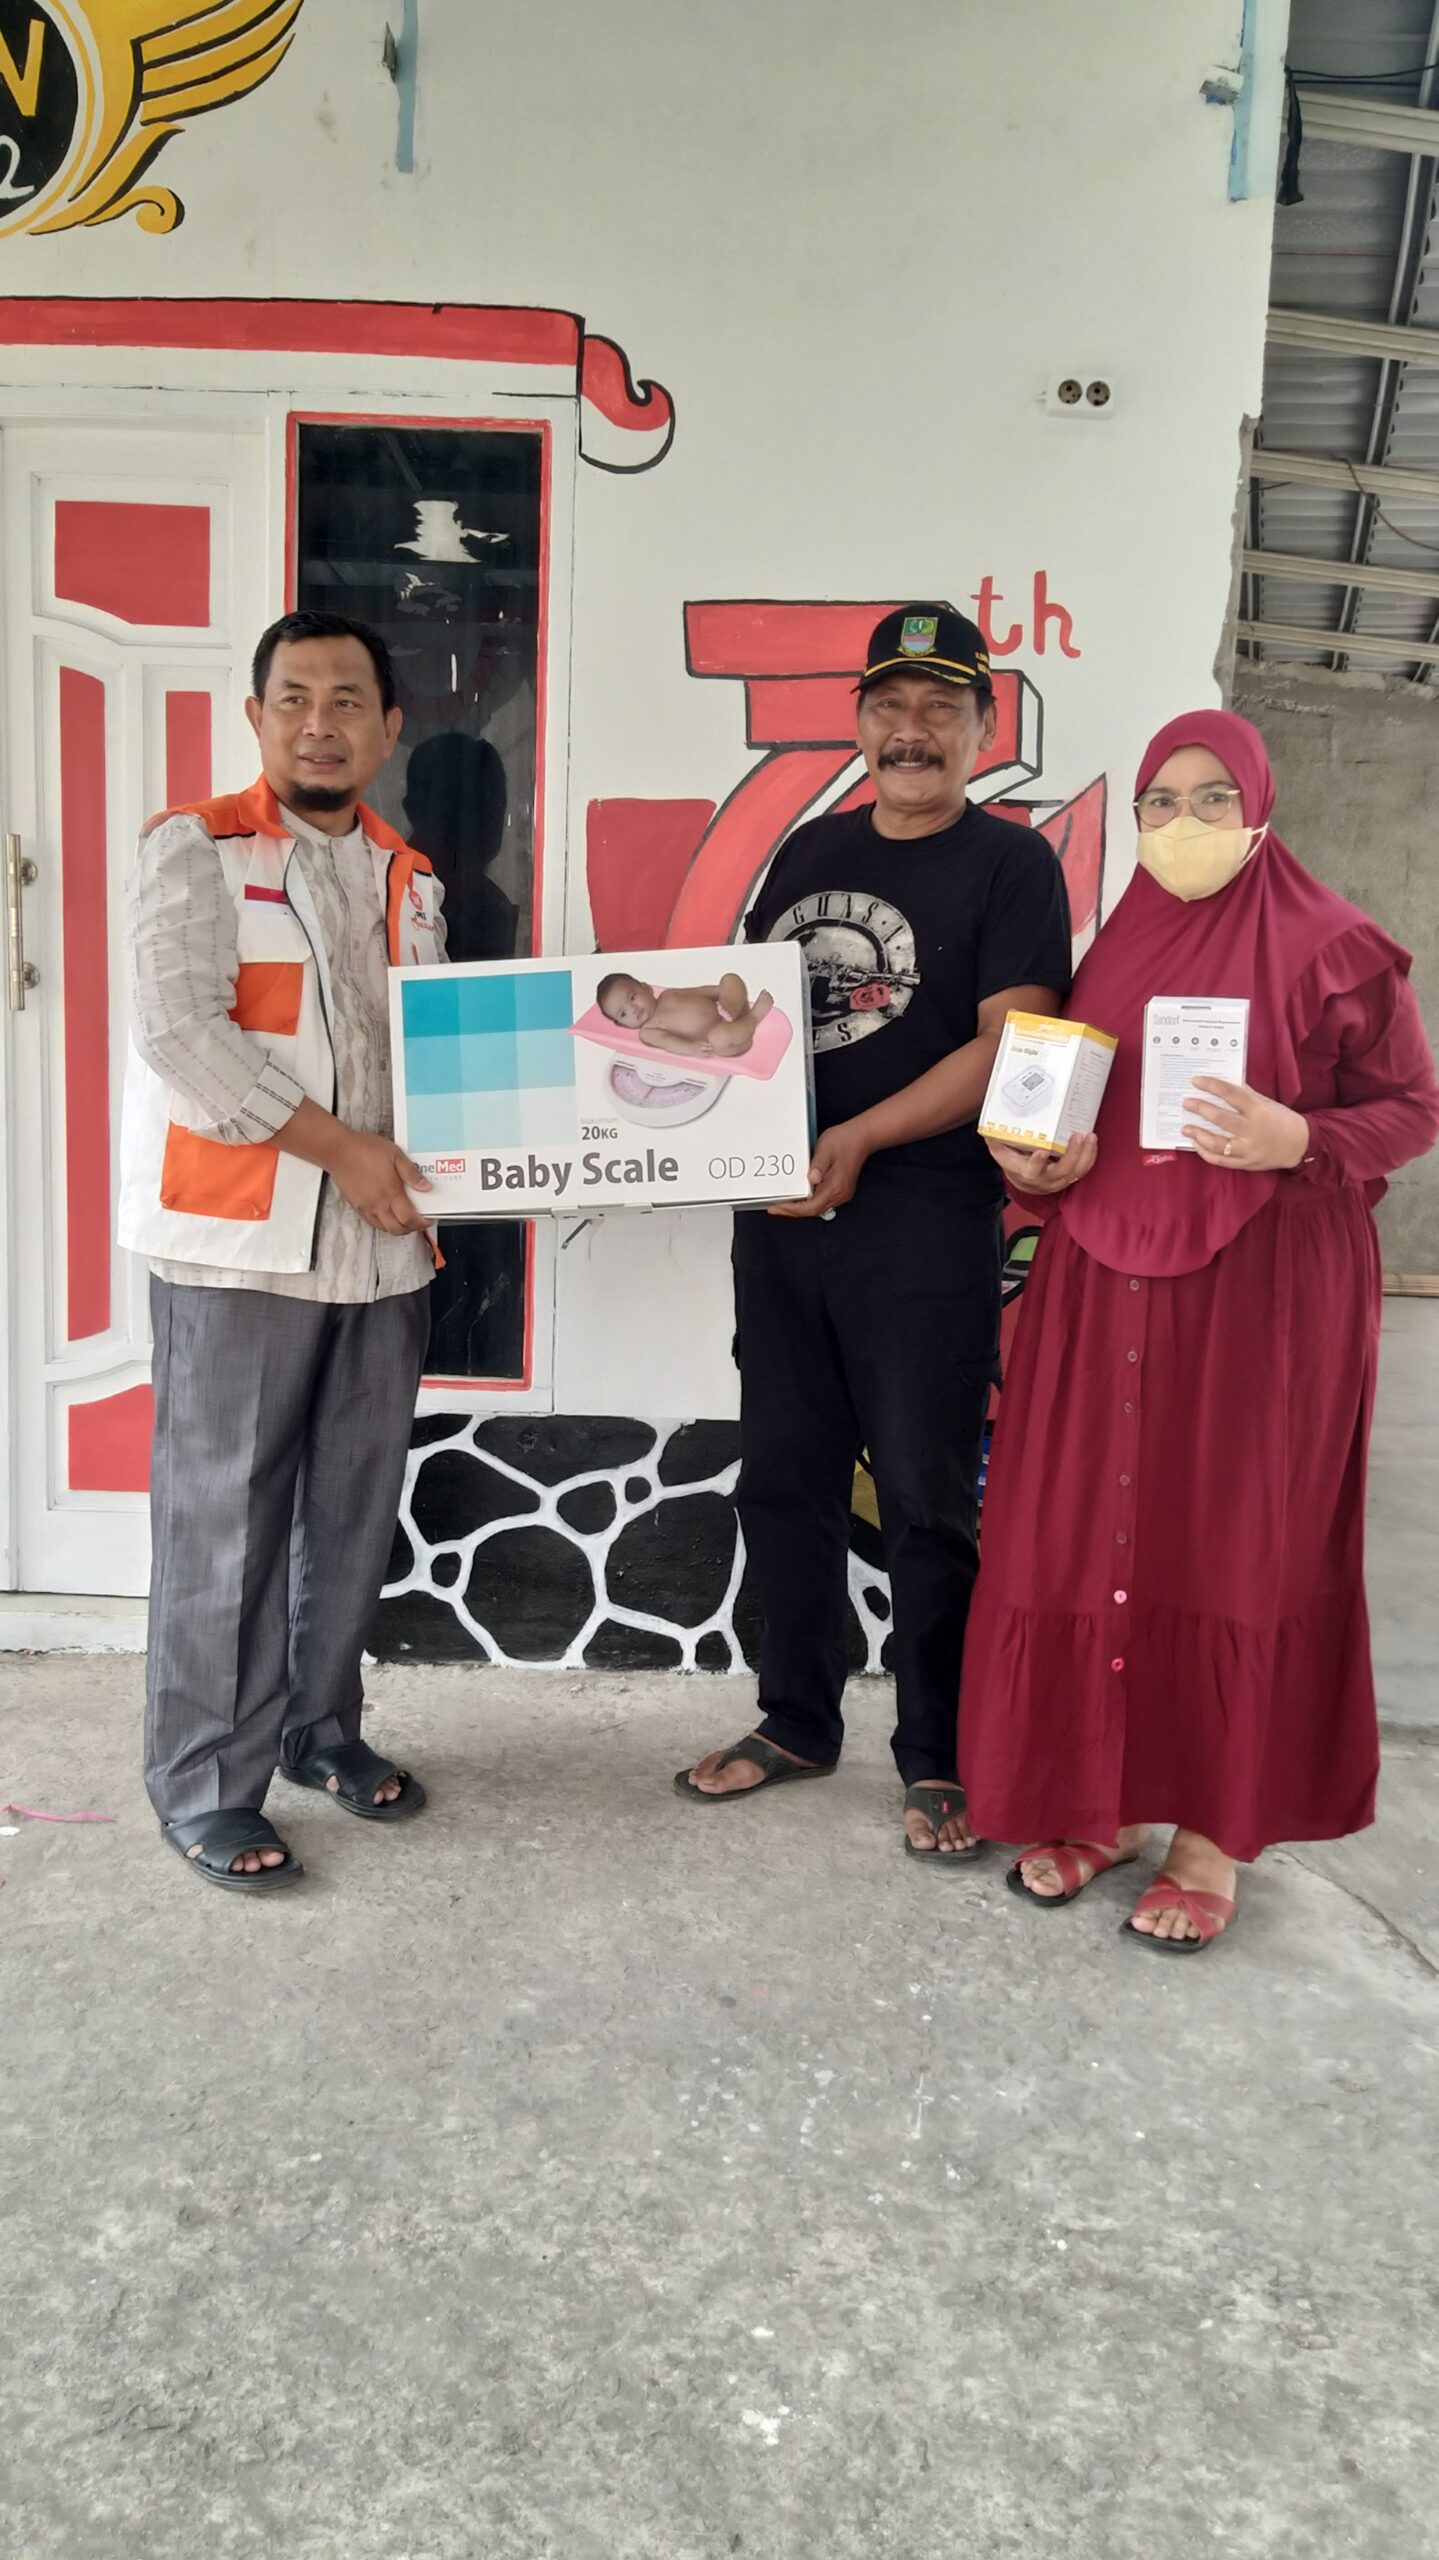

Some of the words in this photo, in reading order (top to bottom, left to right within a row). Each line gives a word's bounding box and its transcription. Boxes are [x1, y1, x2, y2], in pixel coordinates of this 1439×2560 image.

[792, 893, 879, 926] GUNS
[581, 1126, 618, 1141] 20KG
[480, 1155, 572, 1196] Baby
[583, 1149, 679, 1186] Scale
[708, 1157, 746, 1179] OD
[753, 1153, 796, 1178] 230
